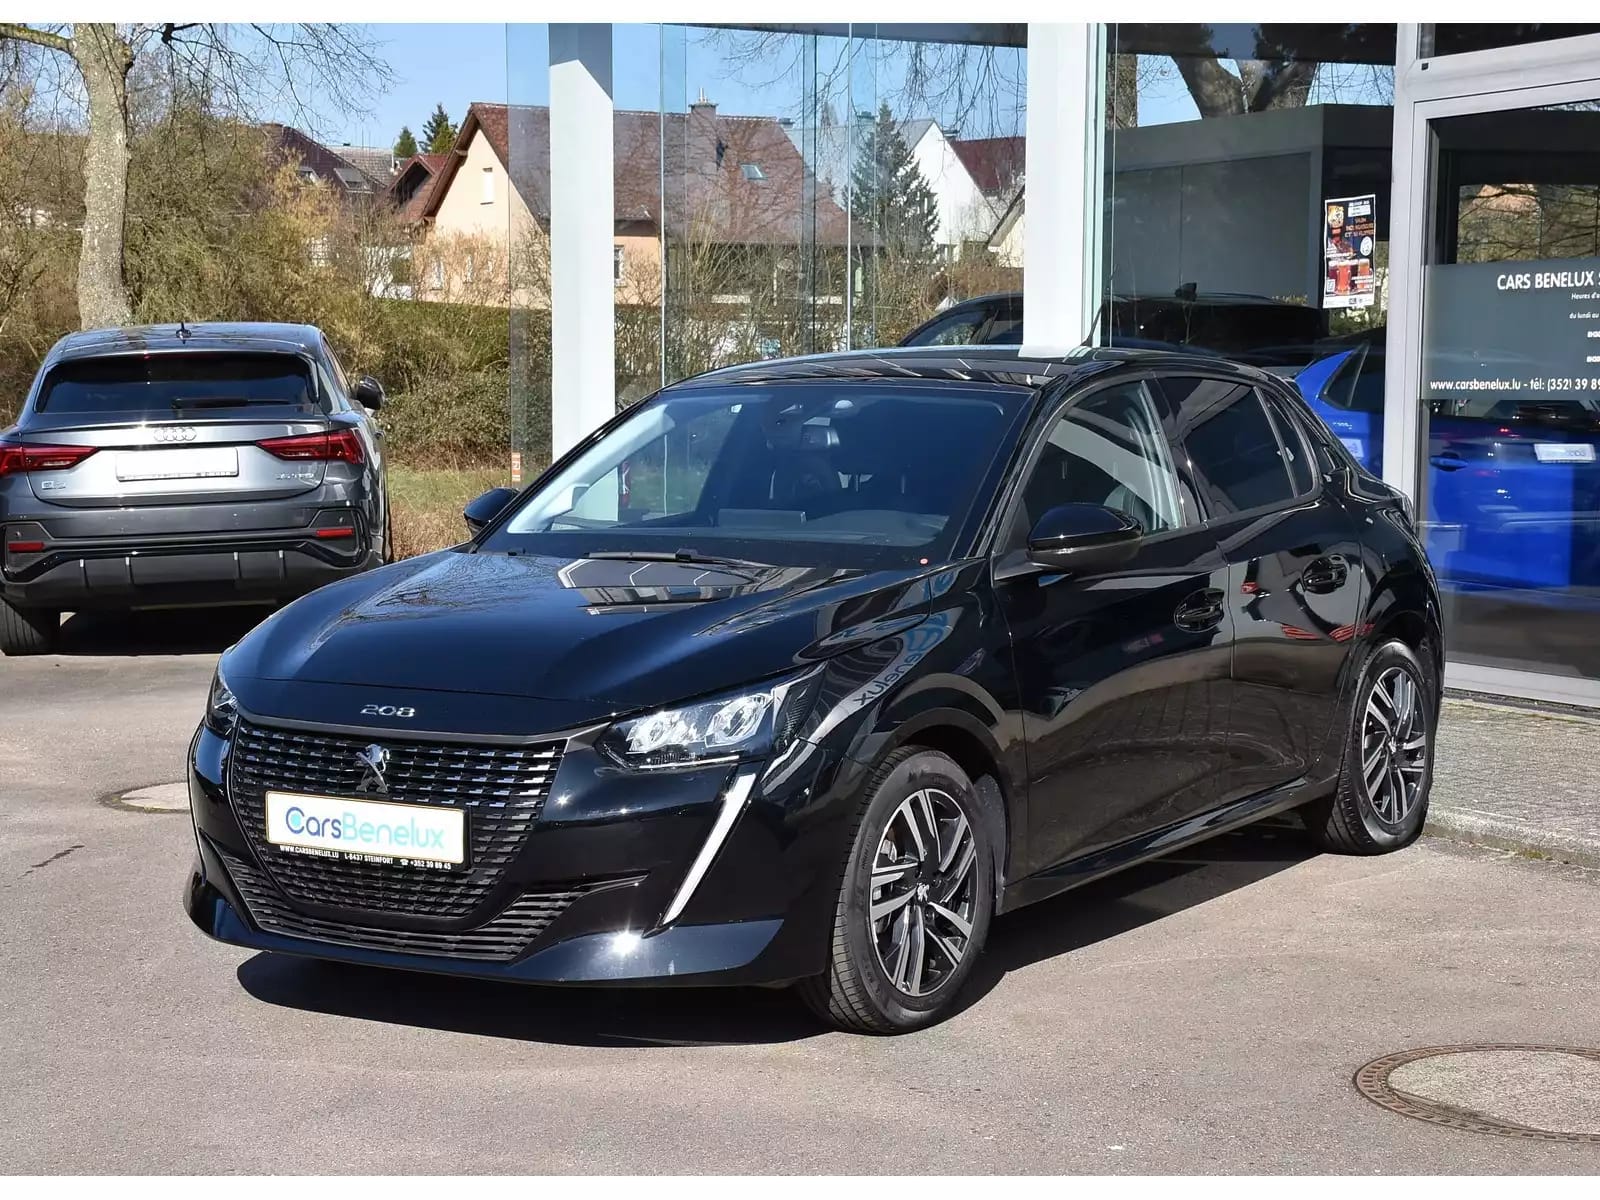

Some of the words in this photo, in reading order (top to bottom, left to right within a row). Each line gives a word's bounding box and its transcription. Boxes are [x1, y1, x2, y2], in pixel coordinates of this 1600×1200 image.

[1497, 274, 1531, 290] CARS
[1534, 271, 1594, 288] BENELUX
[1571, 292, 1591, 300] Heures
[1577, 311, 1591, 319] lundi
[1430, 378, 1521, 390] www.carsbenelux.lu
[1530, 377, 1545, 389] tél:
[1574, 378, 1588, 390] 39
[360, 704, 416, 717] 208
[285, 806, 444, 849] CarsBenelux
[279, 845, 340, 859] WWW.CARSBENELUX.LU
[363, 854, 394, 865] STEINFORT
